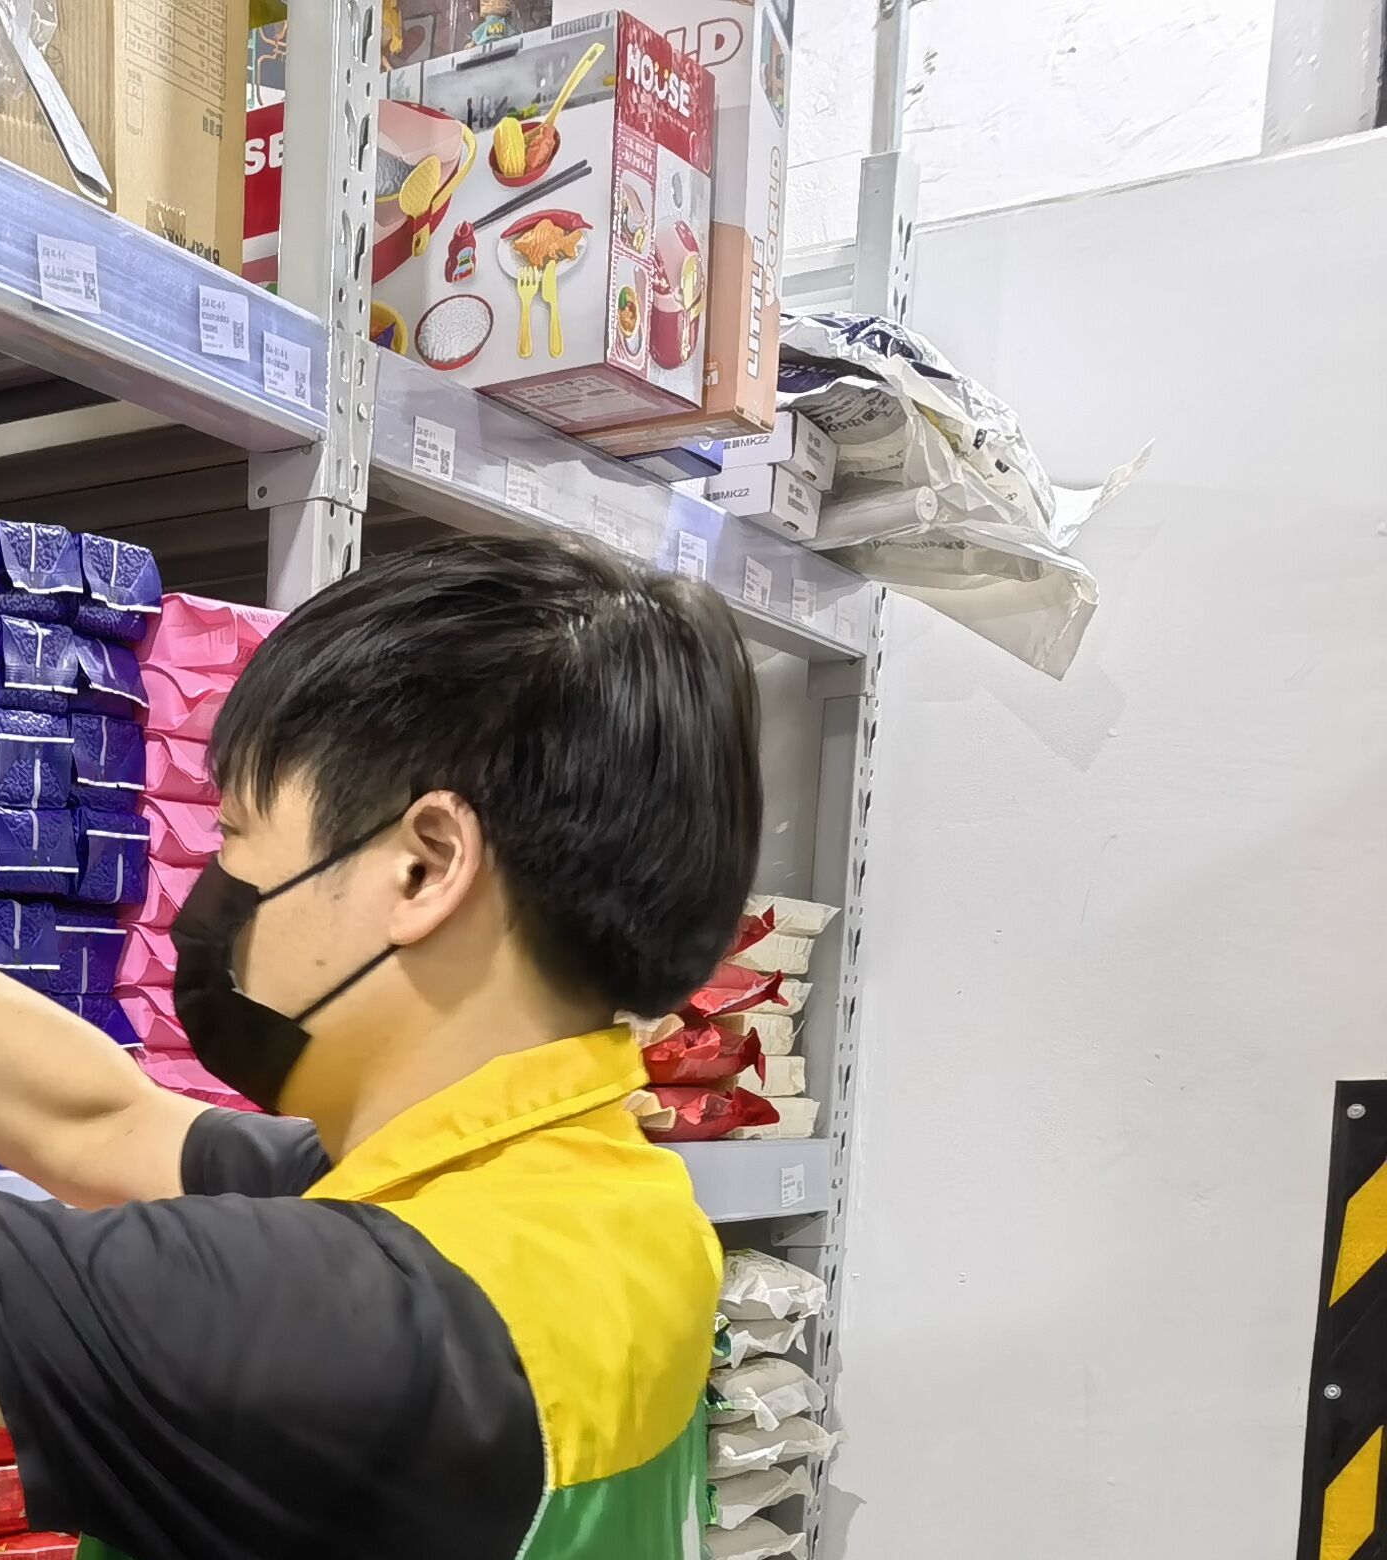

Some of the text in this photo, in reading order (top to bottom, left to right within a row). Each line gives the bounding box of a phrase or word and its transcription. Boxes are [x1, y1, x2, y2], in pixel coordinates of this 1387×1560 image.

[625, 43, 691, 118] HOUSE
[763, 145, 782, 308] WORLD
[746, 235, 765, 380] LITTLE
